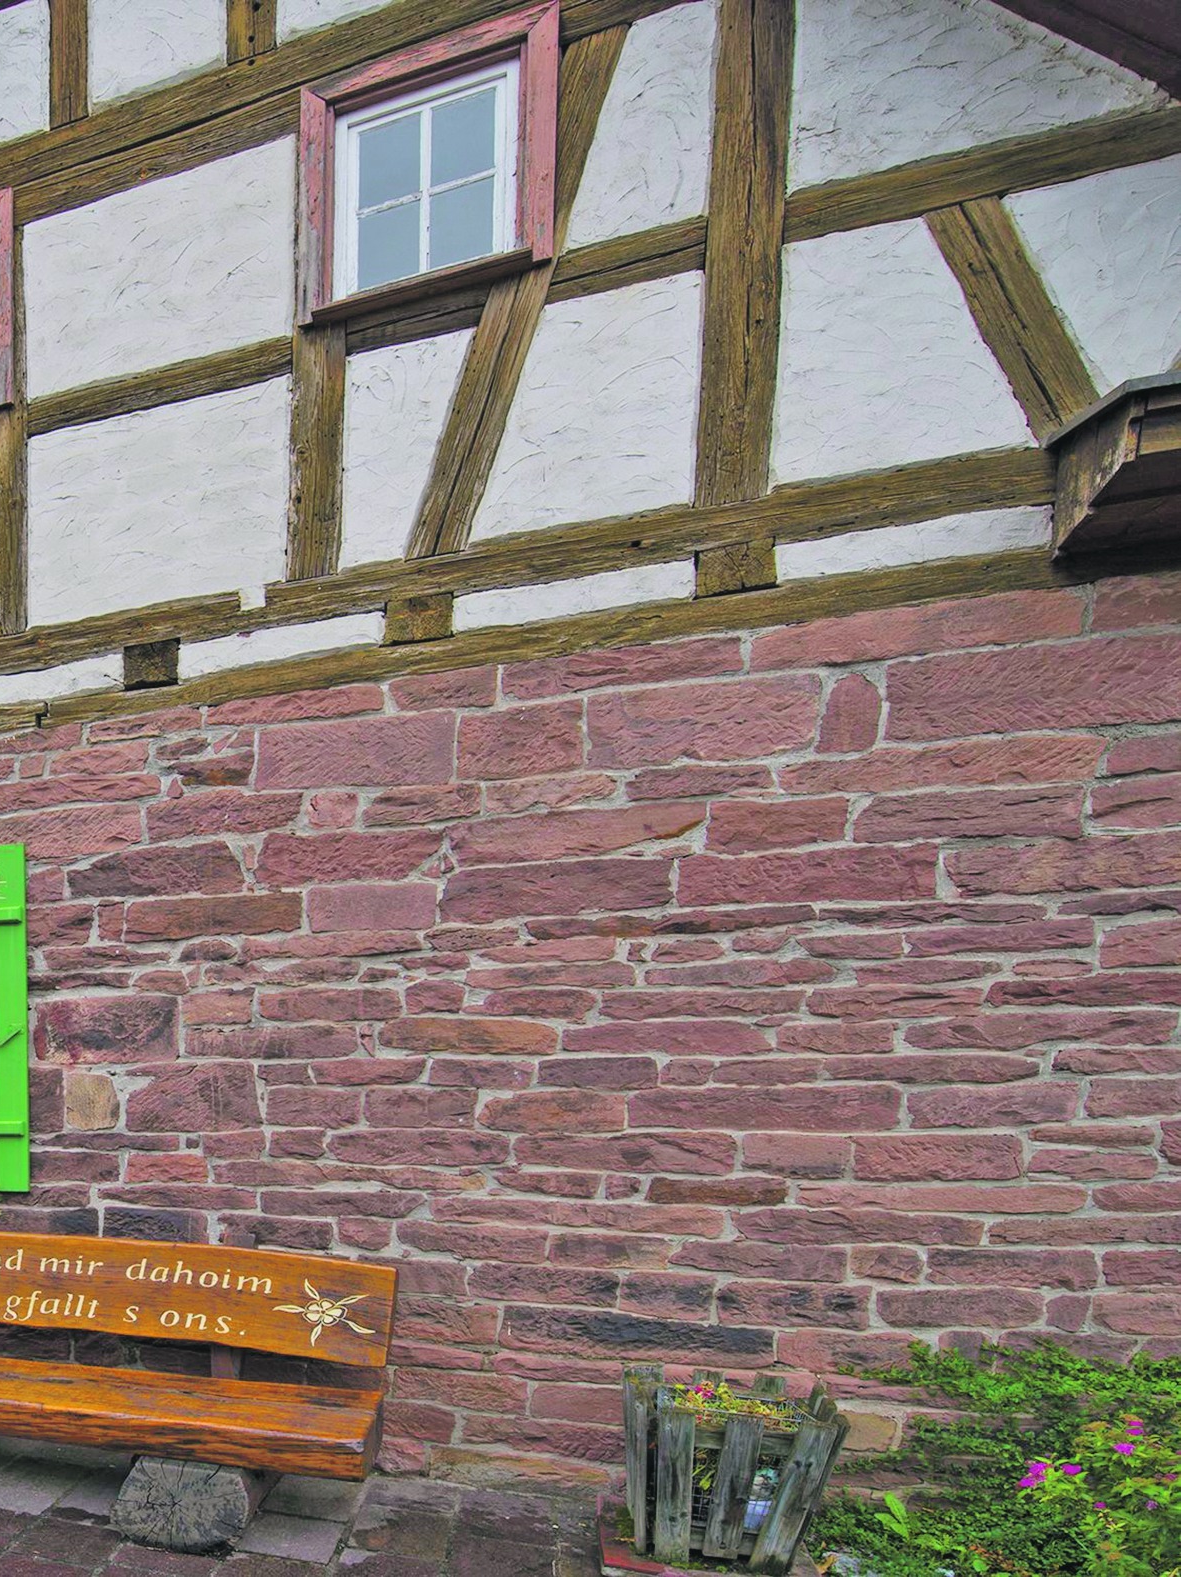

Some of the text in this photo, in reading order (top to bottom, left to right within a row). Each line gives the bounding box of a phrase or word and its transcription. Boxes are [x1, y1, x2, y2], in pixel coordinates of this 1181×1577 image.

[40, 1255, 104, 1275] mir
[125, 1258, 273, 1294] dahoim
[2, 1290, 100, 1321] gfallt
[123, 1306, 140, 1323] s
[160, 1309, 246, 1336] ons.
